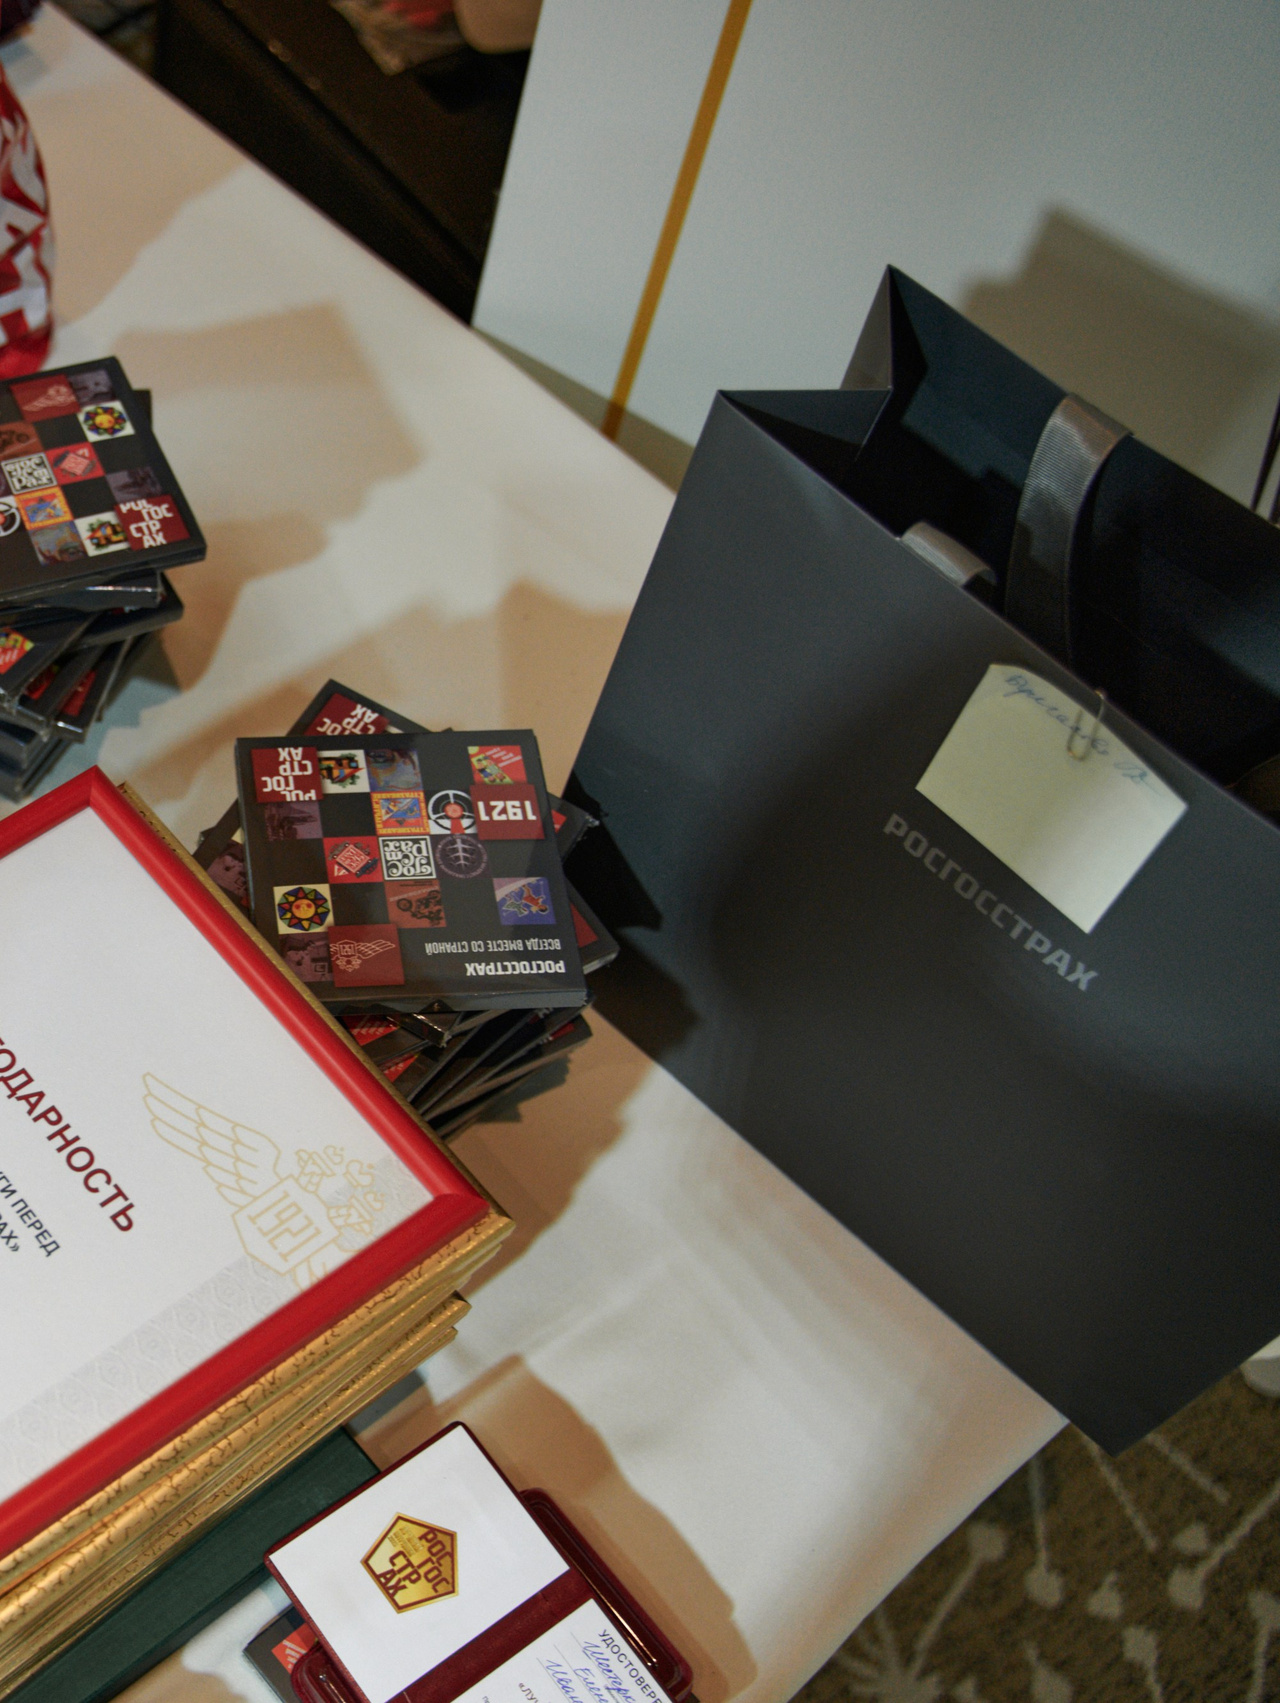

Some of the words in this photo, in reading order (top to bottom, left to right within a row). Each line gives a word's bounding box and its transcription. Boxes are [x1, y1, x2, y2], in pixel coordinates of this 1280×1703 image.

[142, 503, 174, 522] ГОС
[129, 520, 162, 539] СТР
[142, 532, 168, 549] АХ
[278, 747, 303, 762] АХ
[278, 760, 313, 776] СТР
[261, 776, 295, 792] ГОС
[477, 800, 537, 821] 1921
[882, 812, 1099, 993] РОСГОССТРАХ
[424, 942, 469, 956] СТРАНОЙ
[472, 940, 485, 952] СО
[486, 939, 523, 952] ВМЕСТЕ
[525, 938, 562, 951] ВСЕГДА
[464, 960, 566, 976] РОСГОССТРАХ
[10, 1198, 61, 1258] ПЕРЕД
[246, 1189, 322, 1263] 1921
[417, 1527, 453, 1568] РОС
[387, 1548, 422, 1588] СТР
[416, 1555, 450, 1594] ГОС
[377, 1565, 407, 1598] АХ
